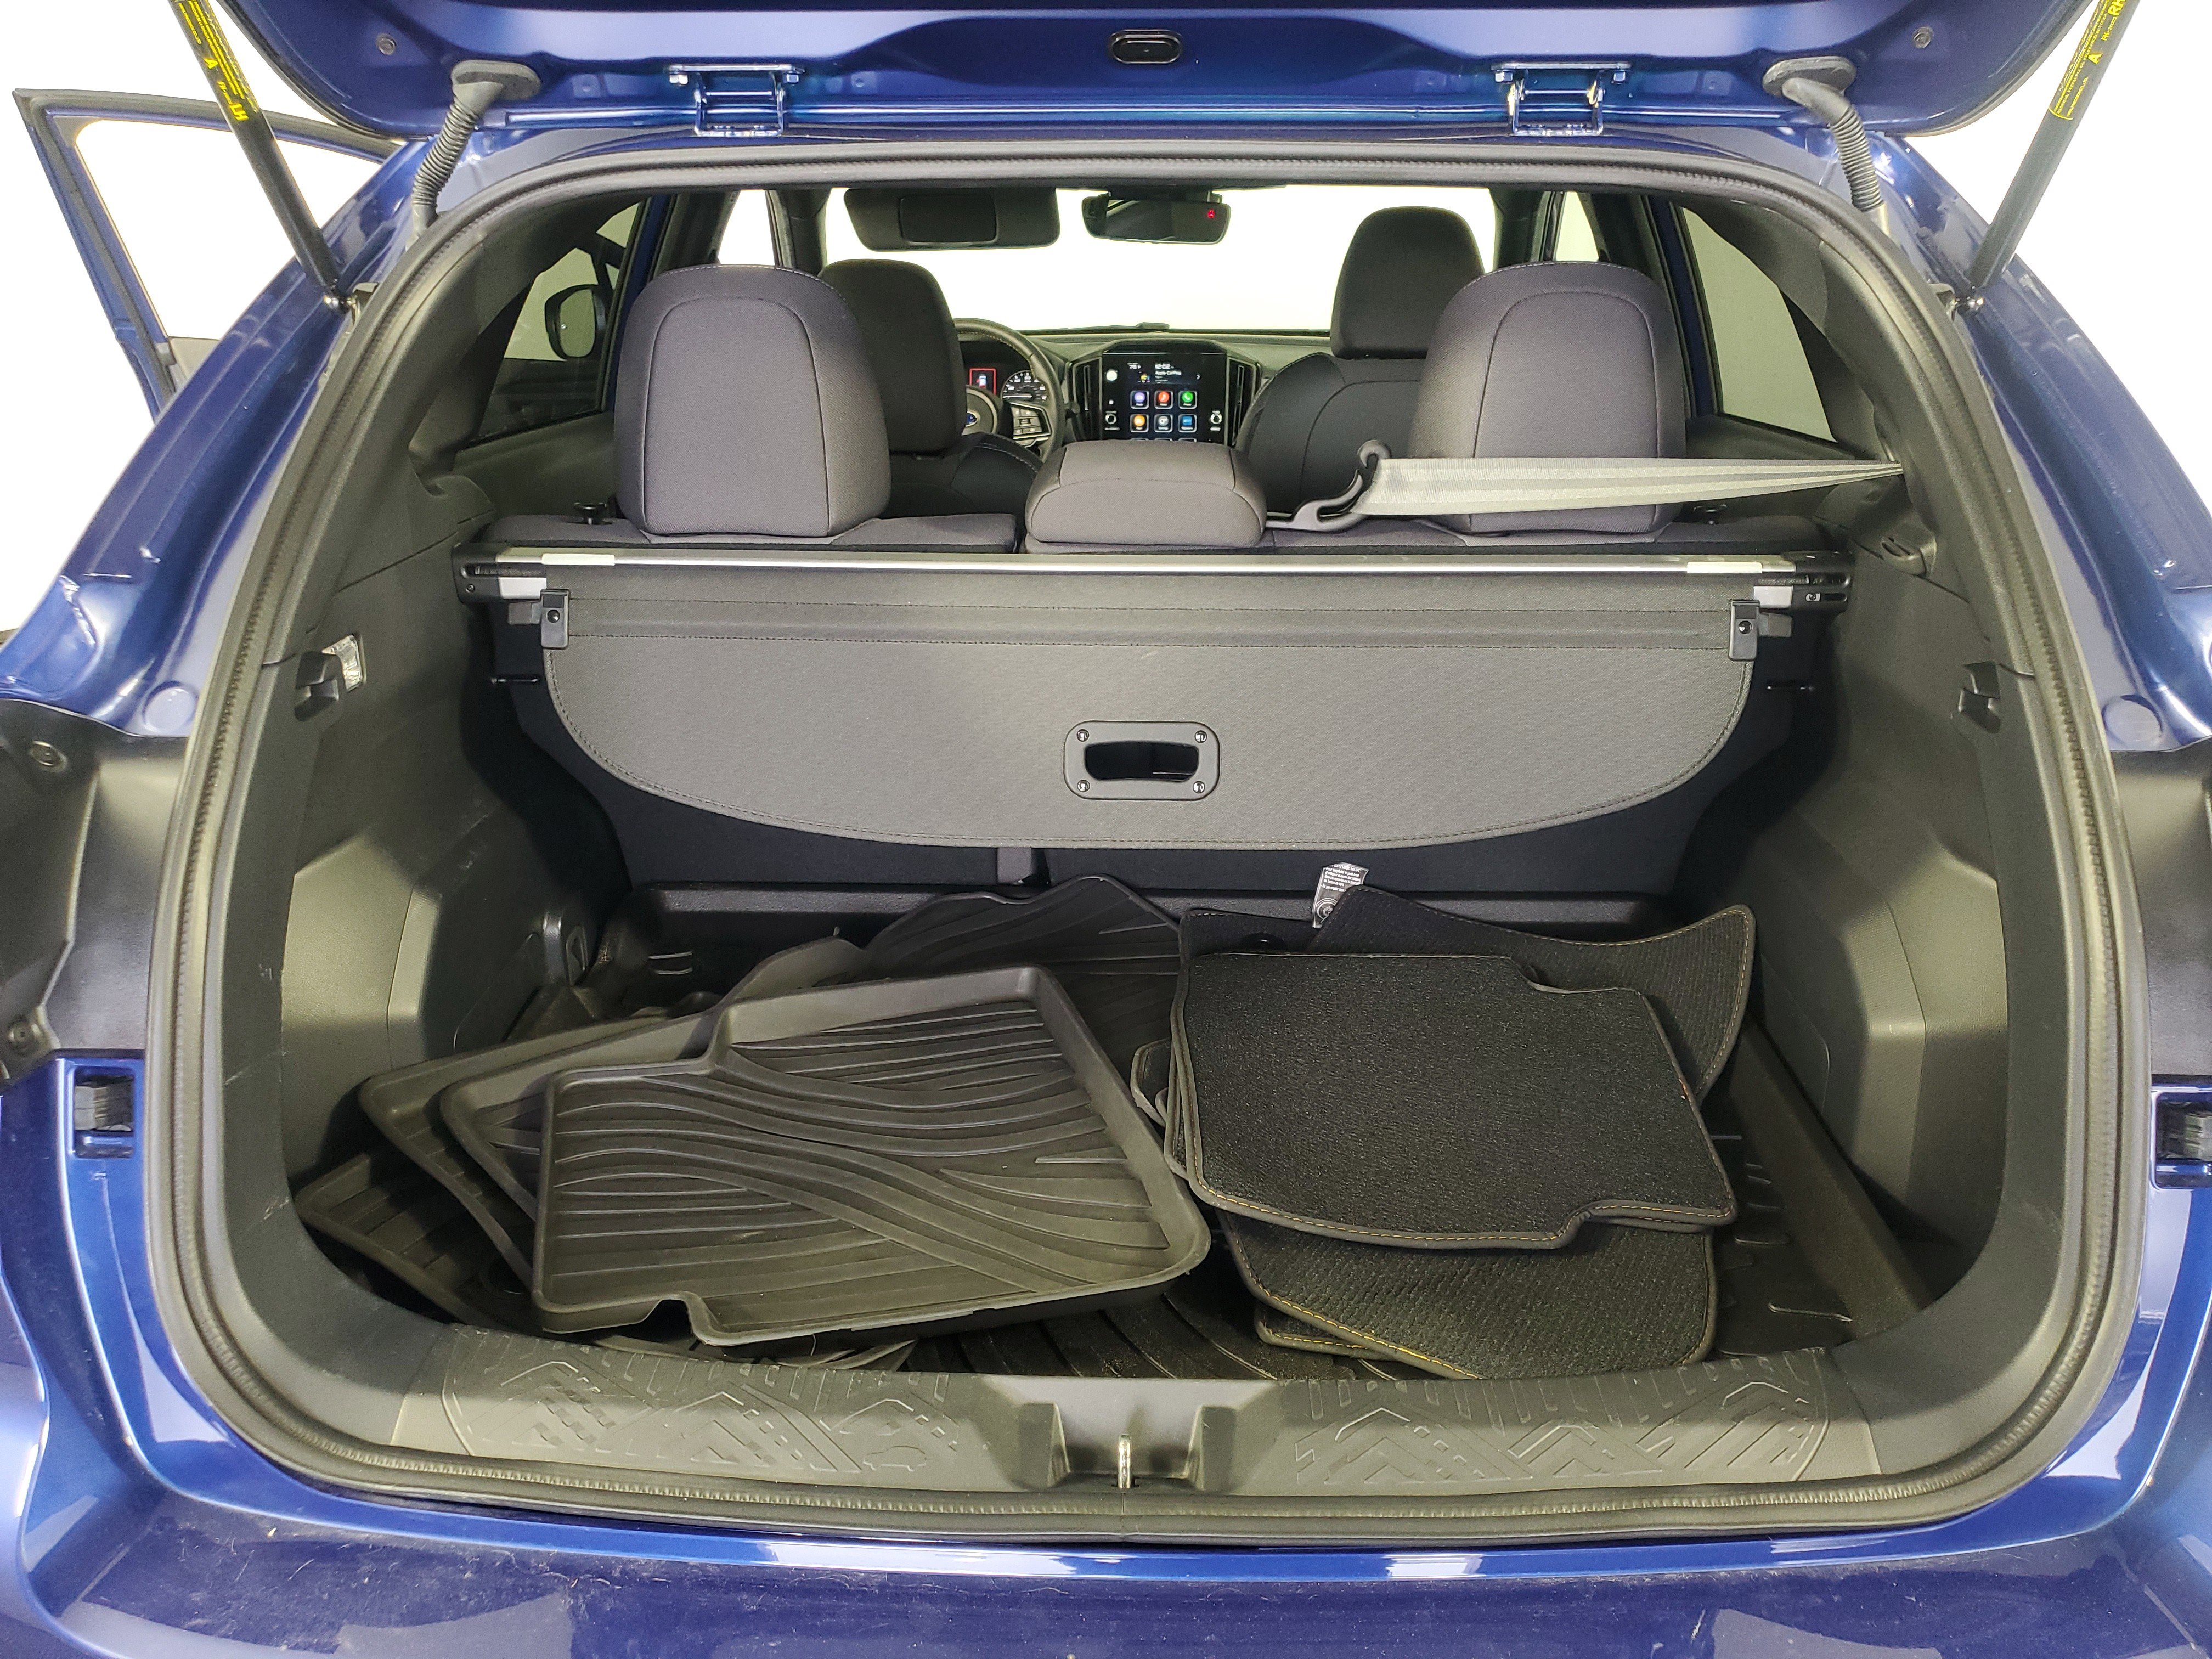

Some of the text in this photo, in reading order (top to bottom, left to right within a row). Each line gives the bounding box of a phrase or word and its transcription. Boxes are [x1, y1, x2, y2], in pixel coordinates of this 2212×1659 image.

[204, 58, 218, 70] A
[2087, 53, 2102, 64] A
[230, 103, 249, 122] LH
